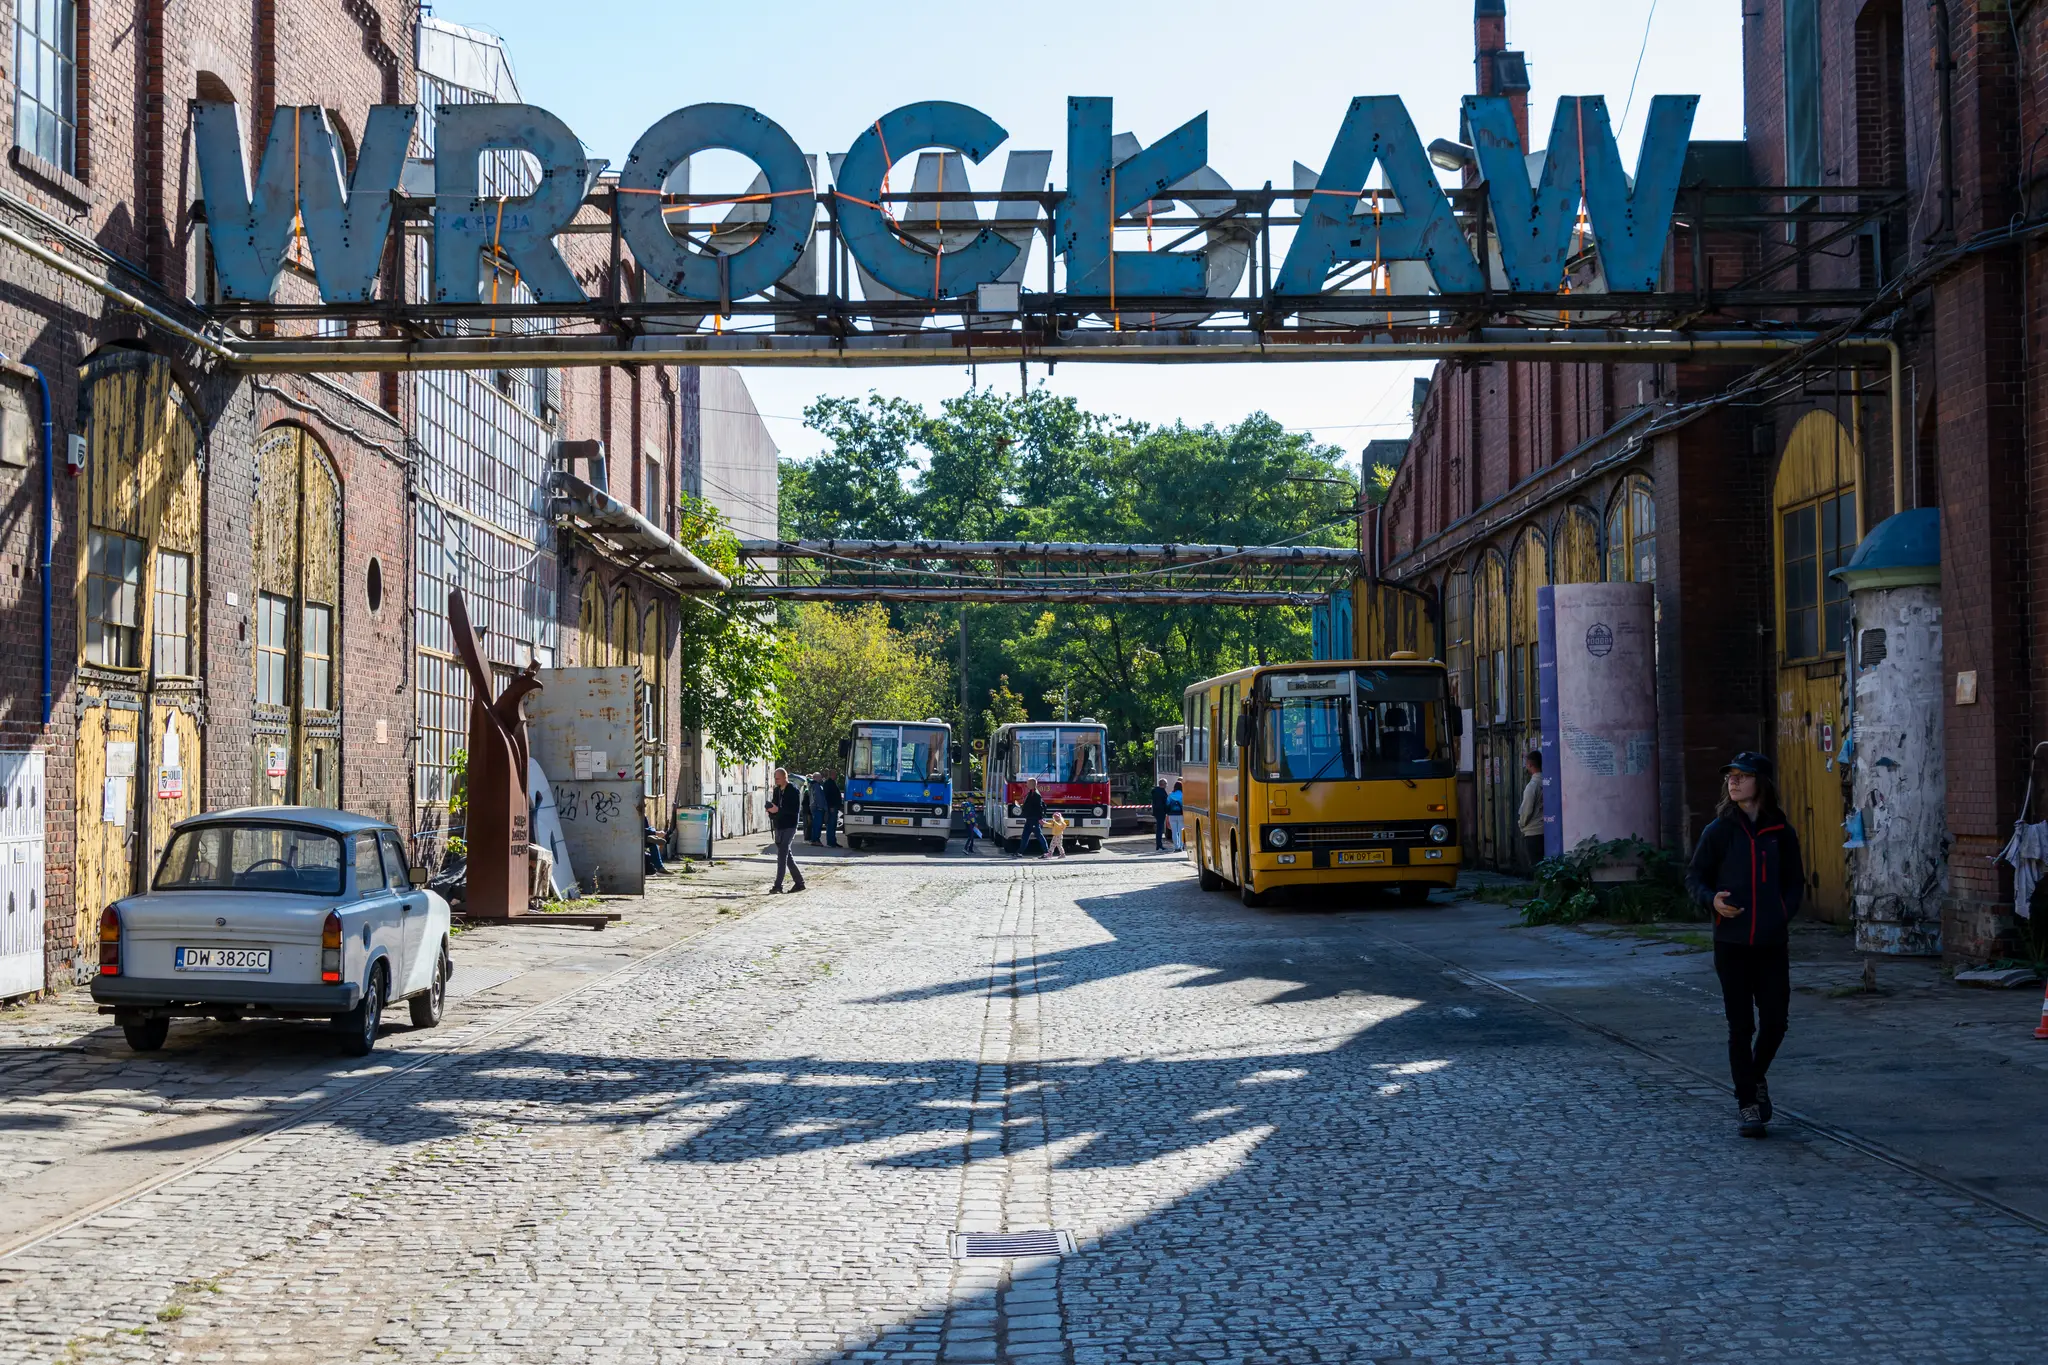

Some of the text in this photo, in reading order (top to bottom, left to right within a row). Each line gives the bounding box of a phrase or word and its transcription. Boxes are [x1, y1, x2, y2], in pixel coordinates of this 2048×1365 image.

[190, 95, 1700, 304] WROCŁAW
[1373, 831, 1395, 840] 260
[187, 950, 210, 965] DW
[216, 951, 267, 967] 382GC
